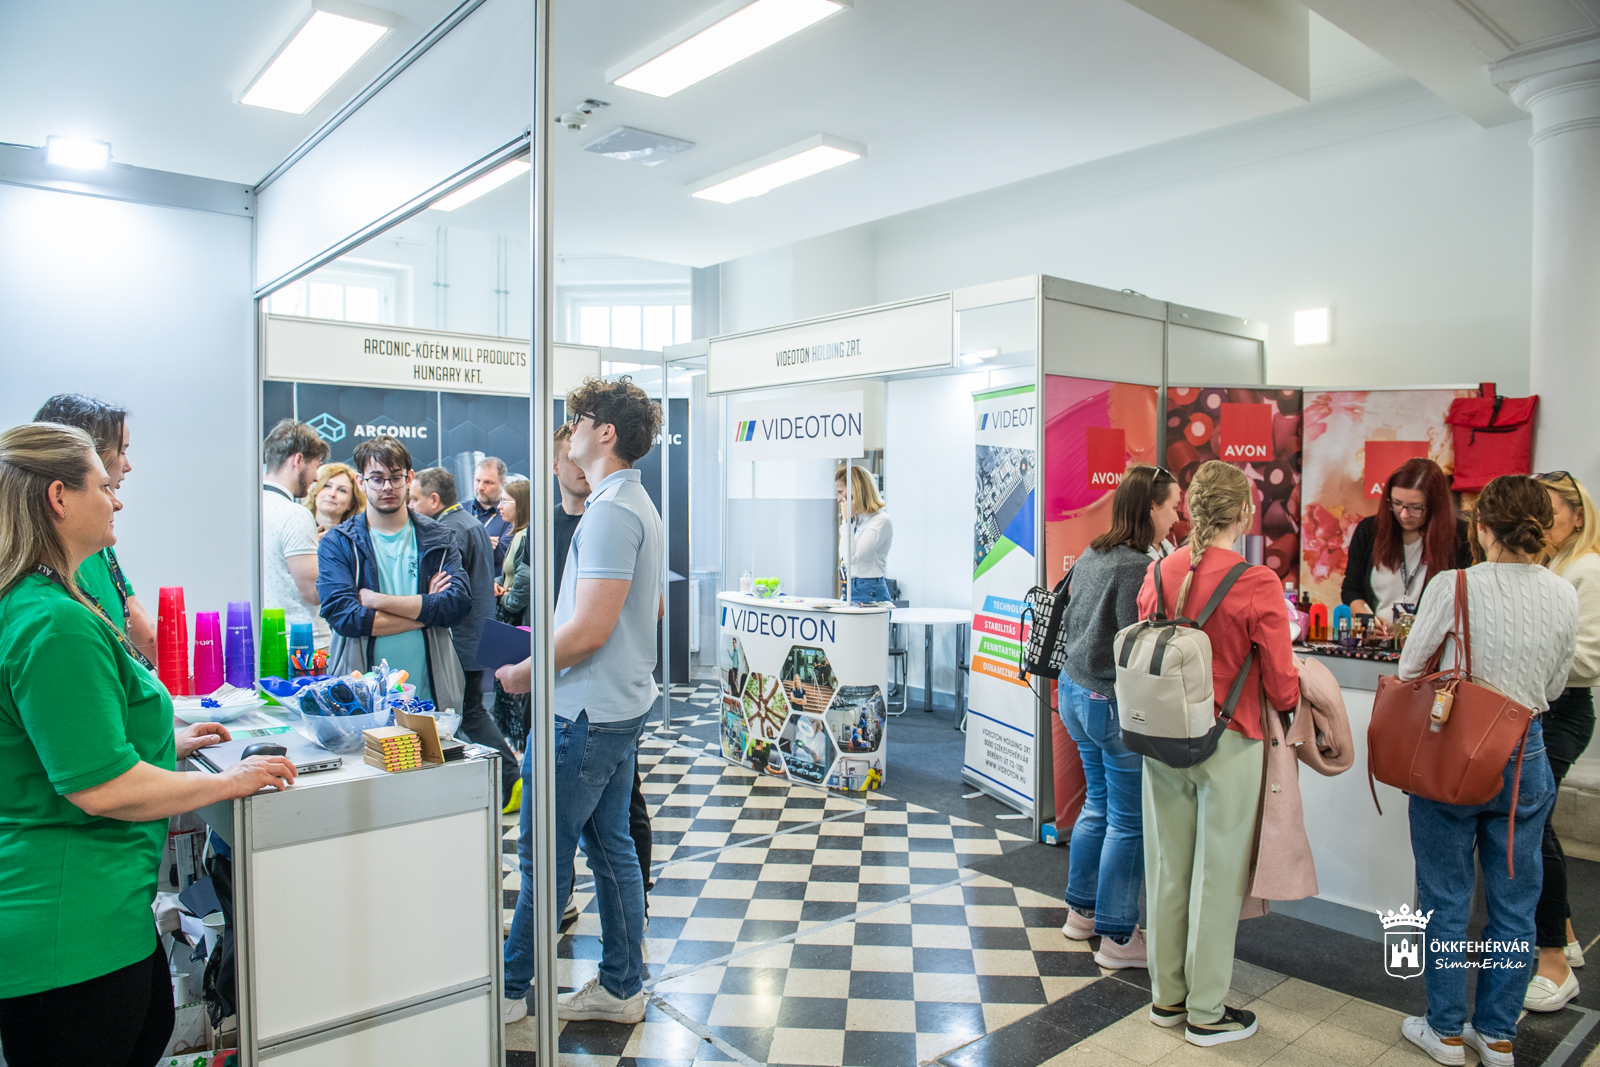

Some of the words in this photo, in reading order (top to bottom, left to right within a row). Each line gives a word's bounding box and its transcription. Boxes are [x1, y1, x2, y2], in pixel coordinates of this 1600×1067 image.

[364, 339, 449, 360] ARCONIC-KÖFÉM
[452, 346, 474, 362] MILL
[477, 349, 527, 366] PRODUCTS
[776, 347, 810, 367] VIDEOTON
[812, 342, 844, 362] HOLDING
[846, 339, 861, 357] ZRT.
[414, 365, 461, 382] HUNGARY
[464, 368, 482, 384] KFT.
[353, 424, 428, 439] ARCONIC
[761, 412, 862, 440] VIDEOTON
[1224, 444, 1267, 457] AVON
[1091, 472, 1123, 485] AVON
[731, 608, 836, 643] VIDEOTON
[984, 620, 1016, 636] STABILITÁS
[982, 727, 1003, 742] VIDEOTON
[1003, 736, 1023, 751] HOLDING
[984, 738, 994, 749] 8000
